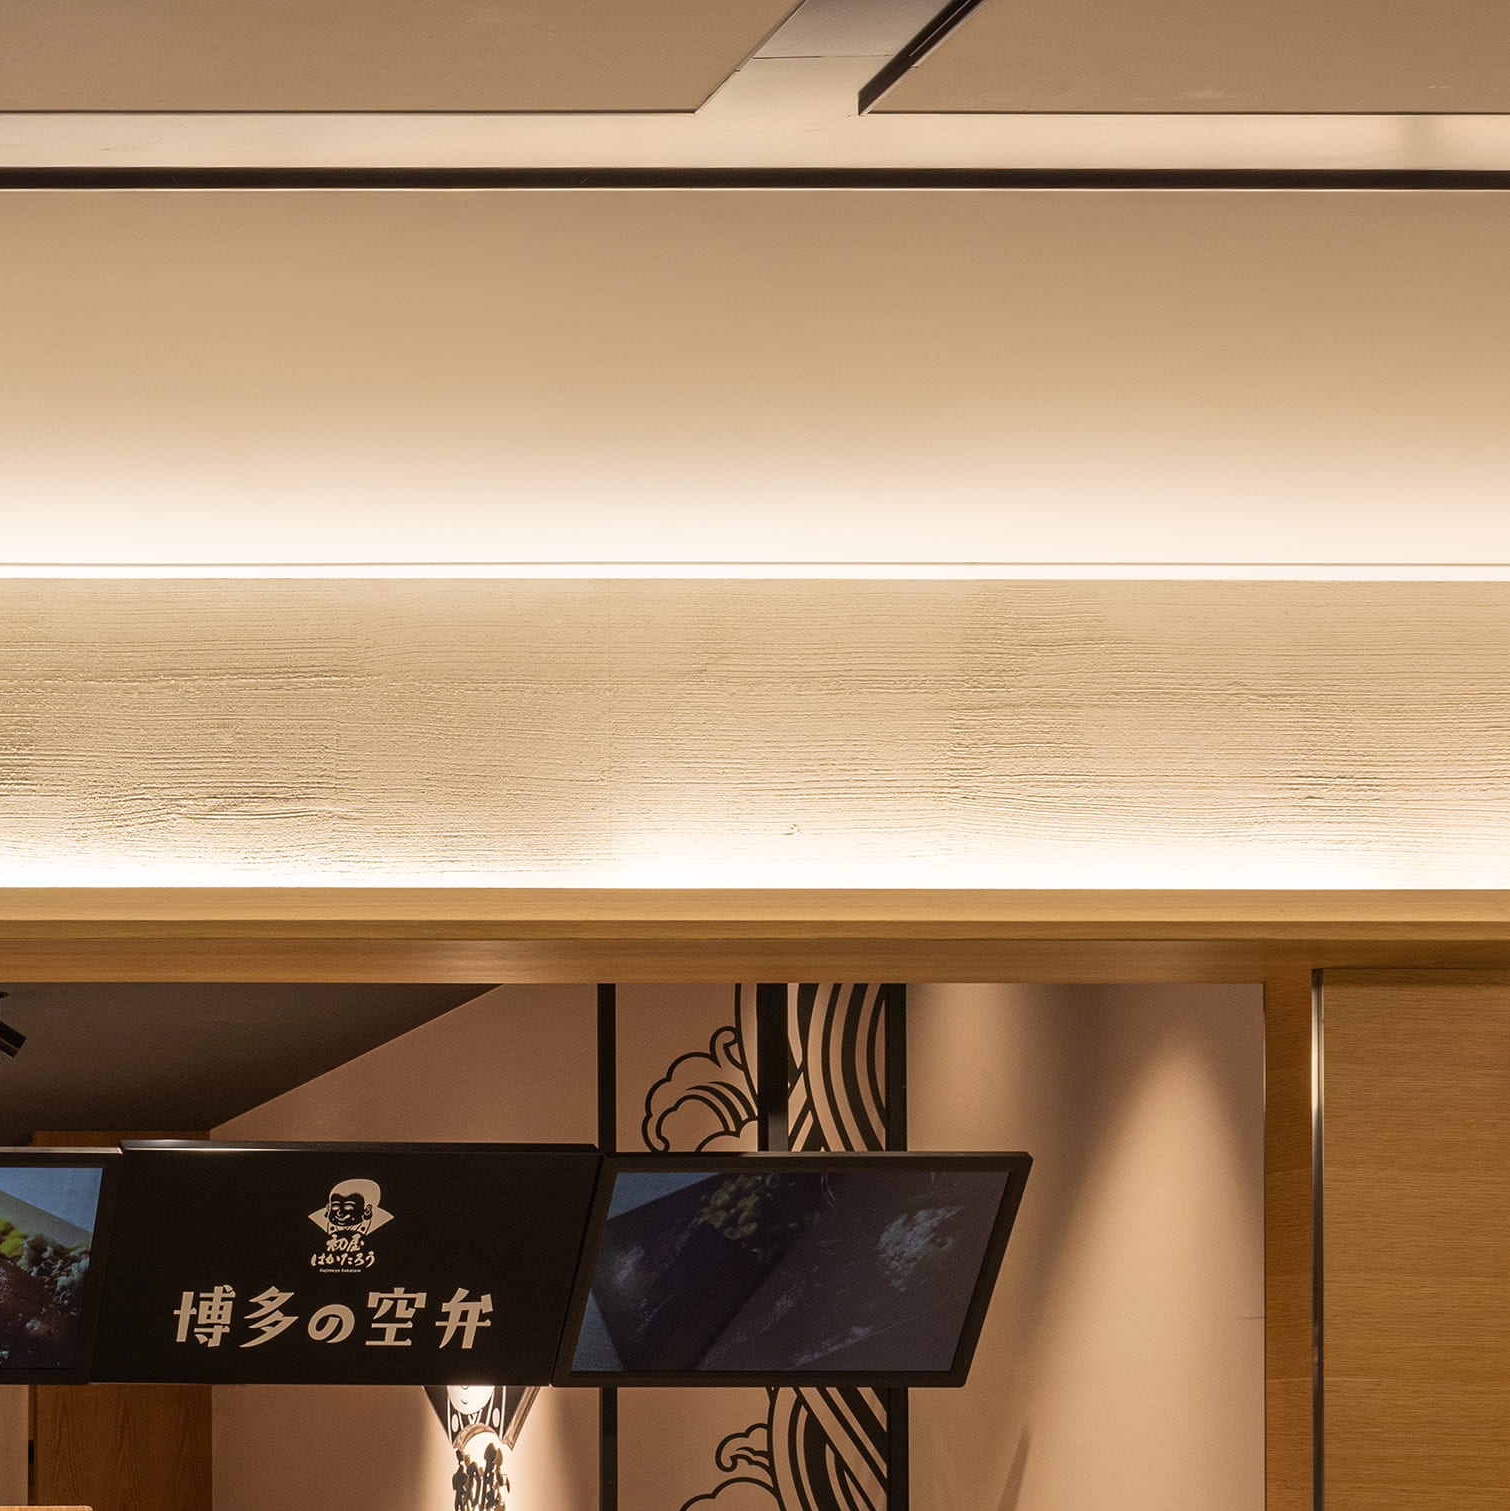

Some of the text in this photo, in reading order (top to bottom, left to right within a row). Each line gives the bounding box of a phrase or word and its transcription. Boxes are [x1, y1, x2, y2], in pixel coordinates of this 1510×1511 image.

[310, 1251, 375, 1269] はかたろう
[172, 1284, 494, 1350] 博多の空弁
